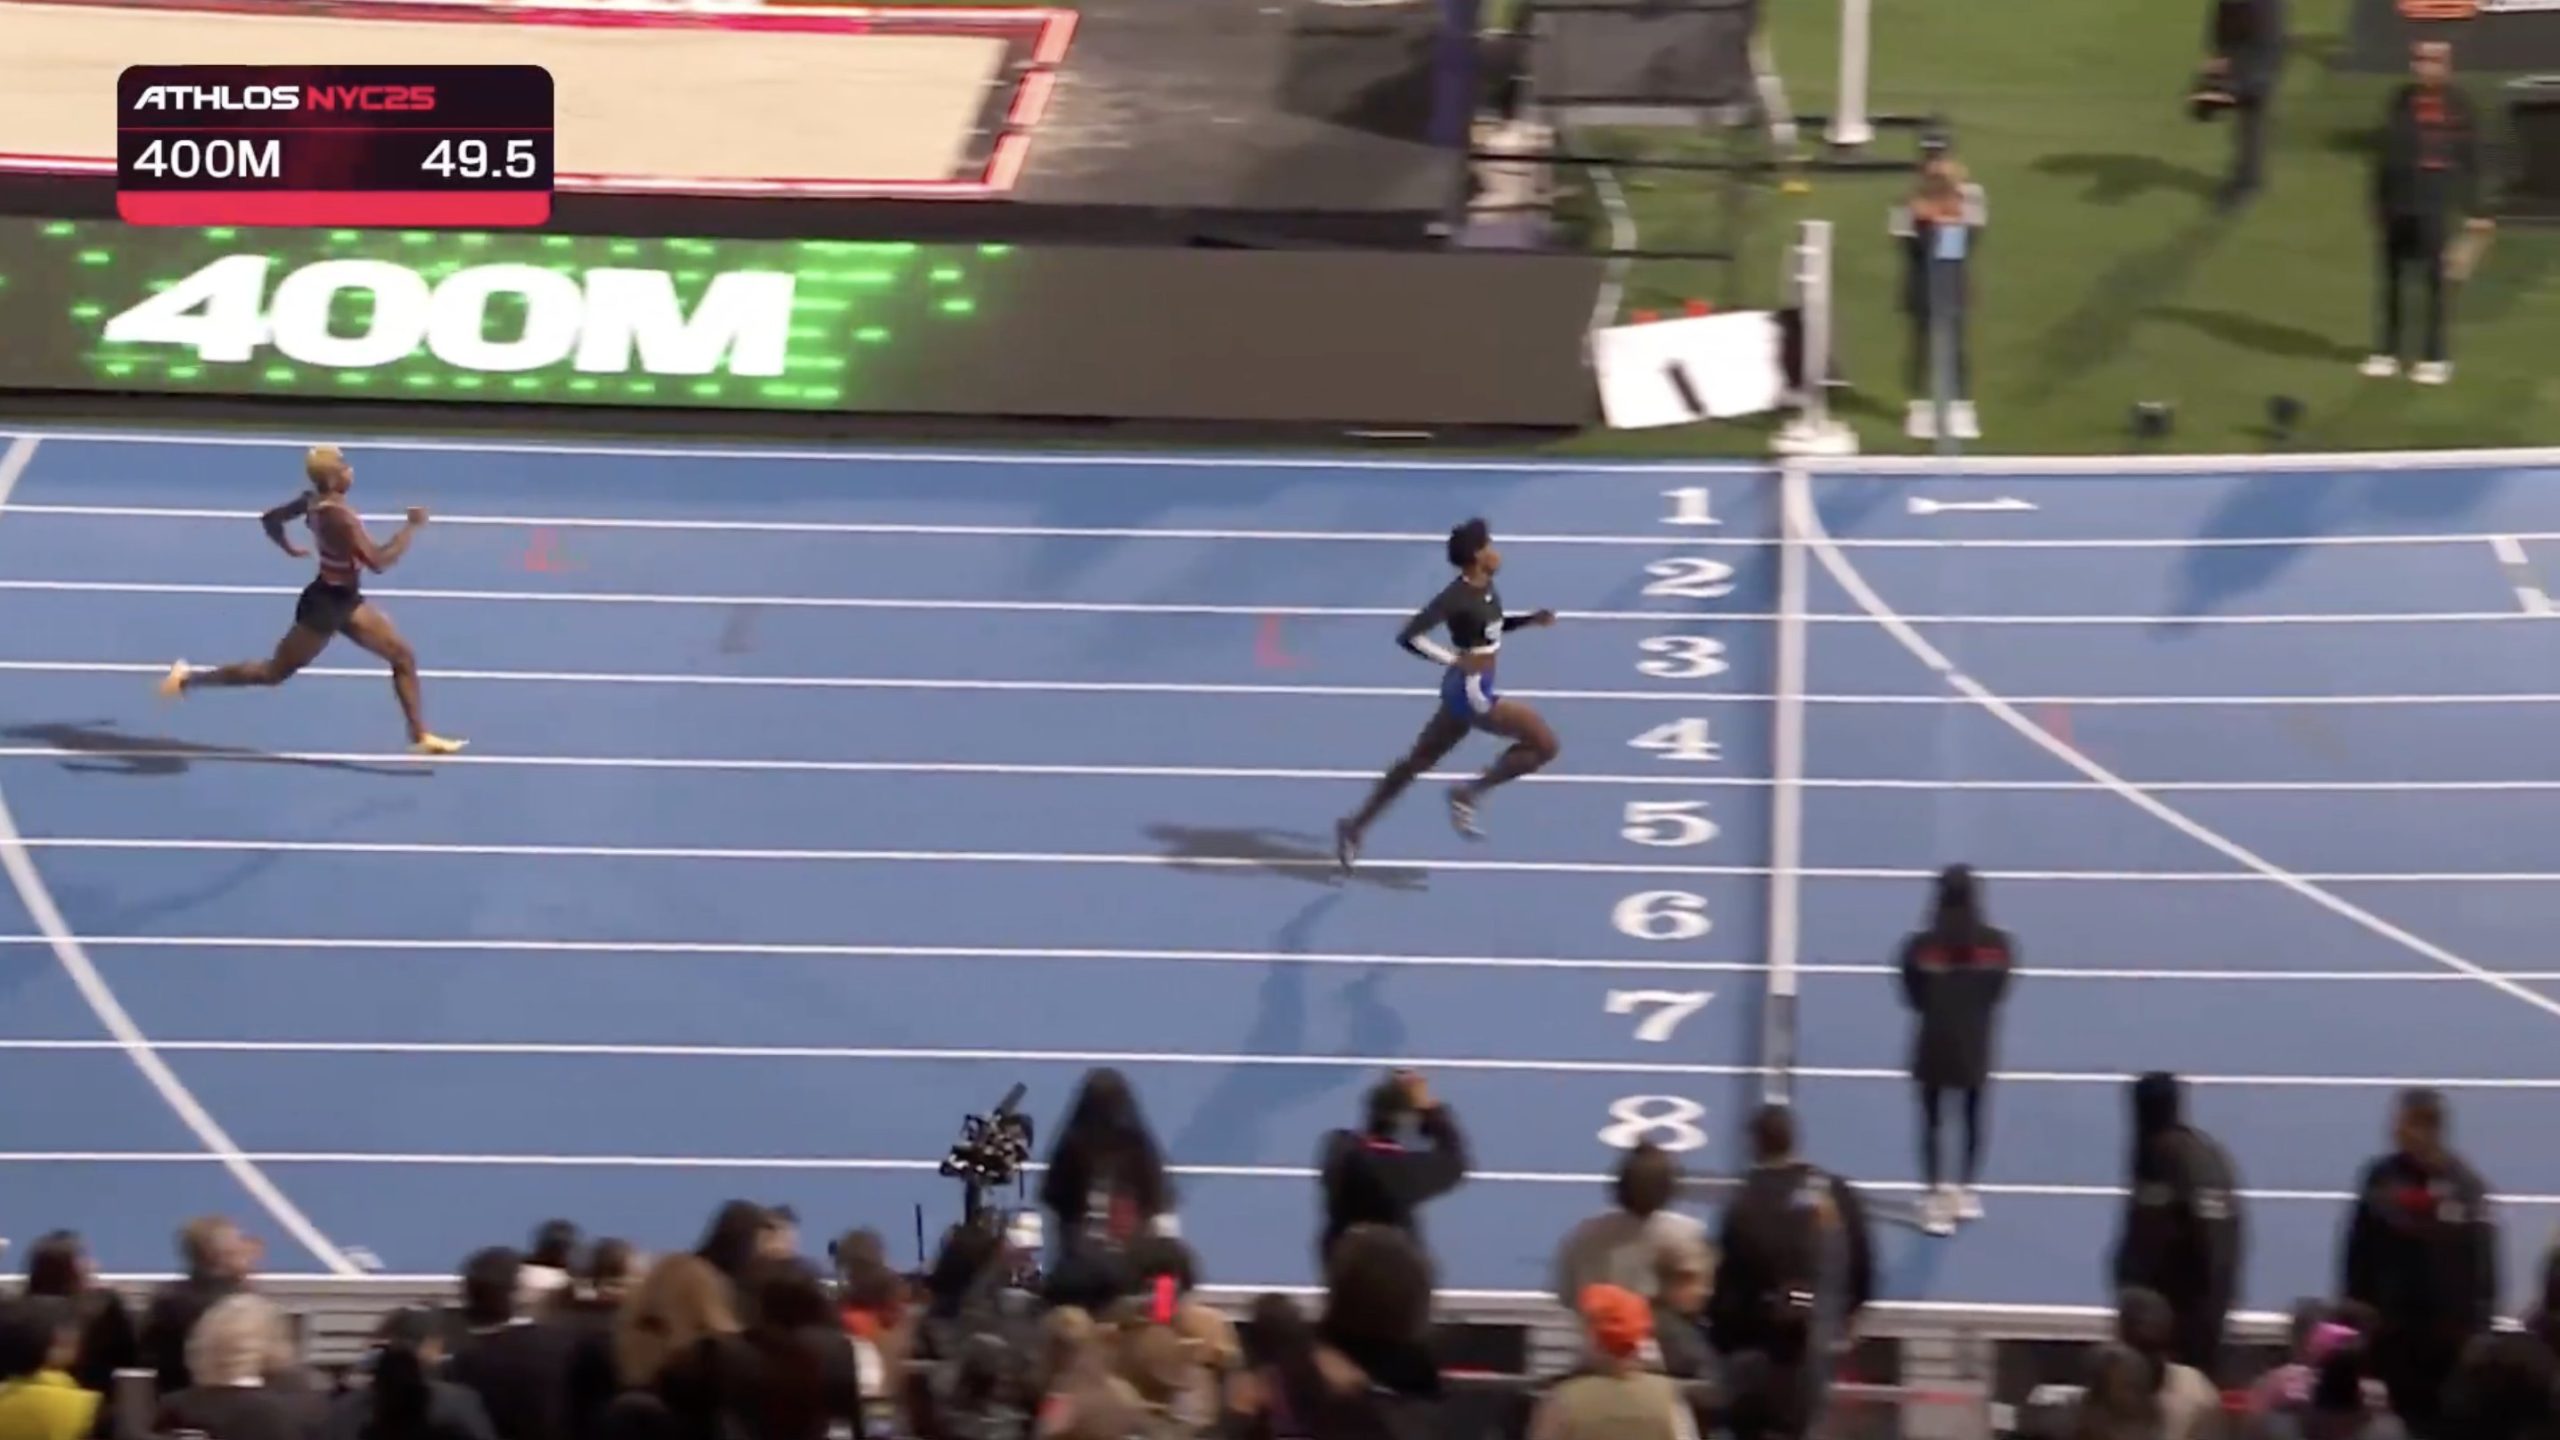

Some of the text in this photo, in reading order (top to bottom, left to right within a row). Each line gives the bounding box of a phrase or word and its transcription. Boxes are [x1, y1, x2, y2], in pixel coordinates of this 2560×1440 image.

[104, 254, 796, 377] 400M
[1659, 485, 1723, 526] 1
[1641, 556, 1735, 598] 2
[1635, 634, 1730, 679] 3
[1626, 716, 1722, 761] 4
[1620, 799, 1720, 848] 5
[1611, 889, 1713, 941] 6
[1604, 988, 1716, 1042] 7
[1597, 1094, 1709, 1152] 8
